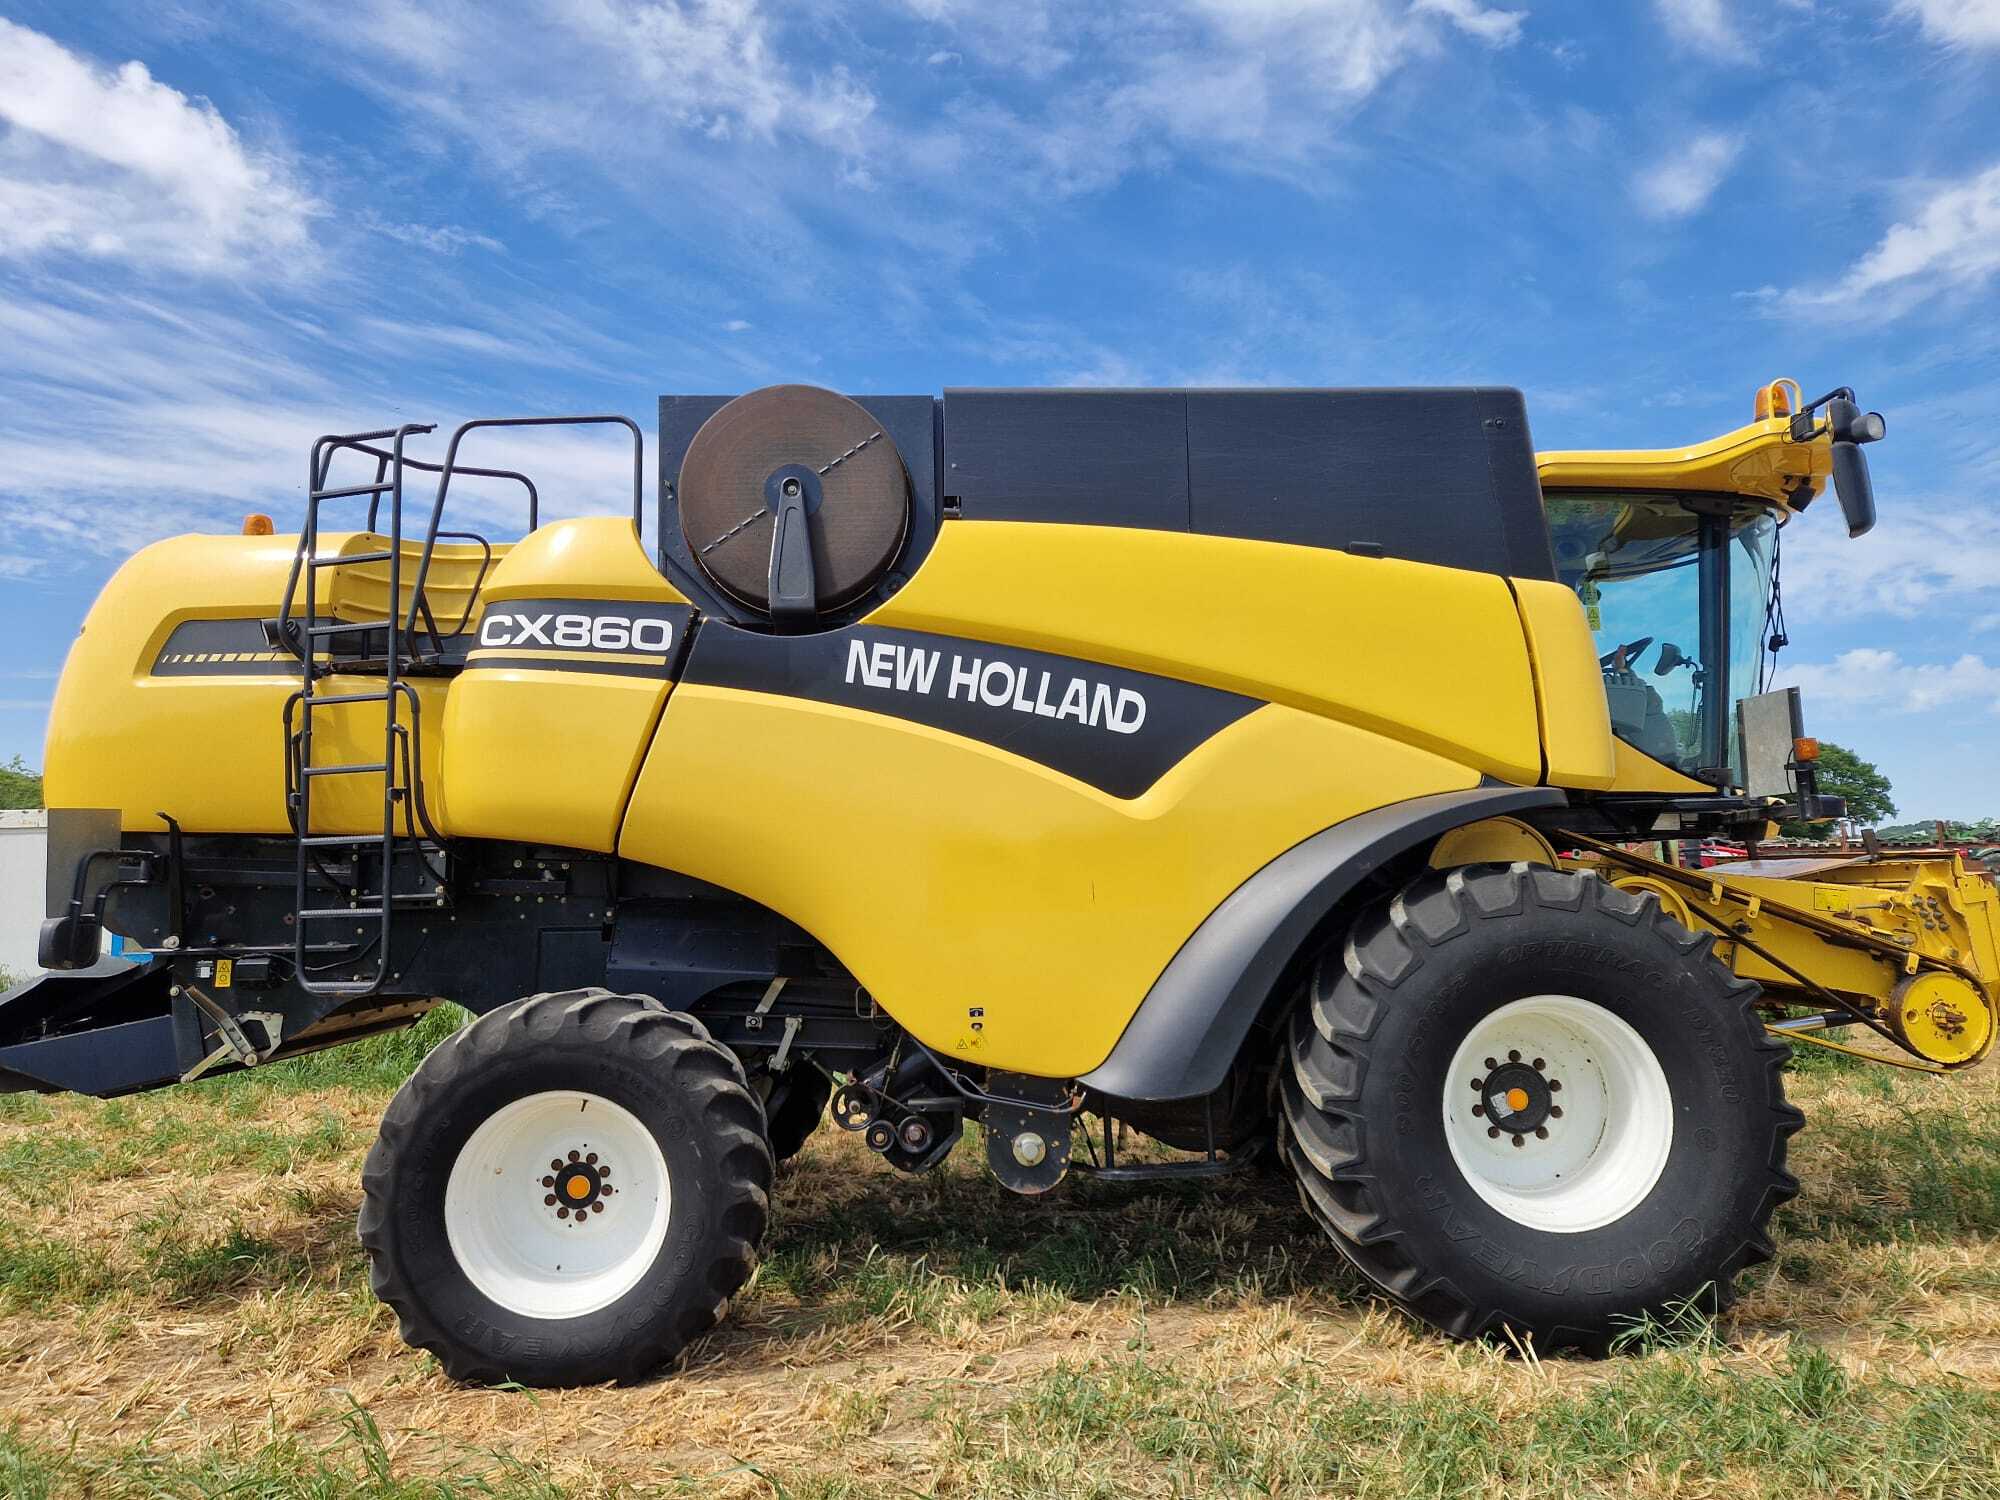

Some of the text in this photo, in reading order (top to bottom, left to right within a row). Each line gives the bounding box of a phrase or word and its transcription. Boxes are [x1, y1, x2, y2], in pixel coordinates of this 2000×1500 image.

[480, 614, 673, 652] CX860
[845, 639, 1147, 734] NEW HOLLAND
[454, 1212, 704, 1361] GOODYEAR
[1414, 1173, 1705, 1296] GOODYEAR
